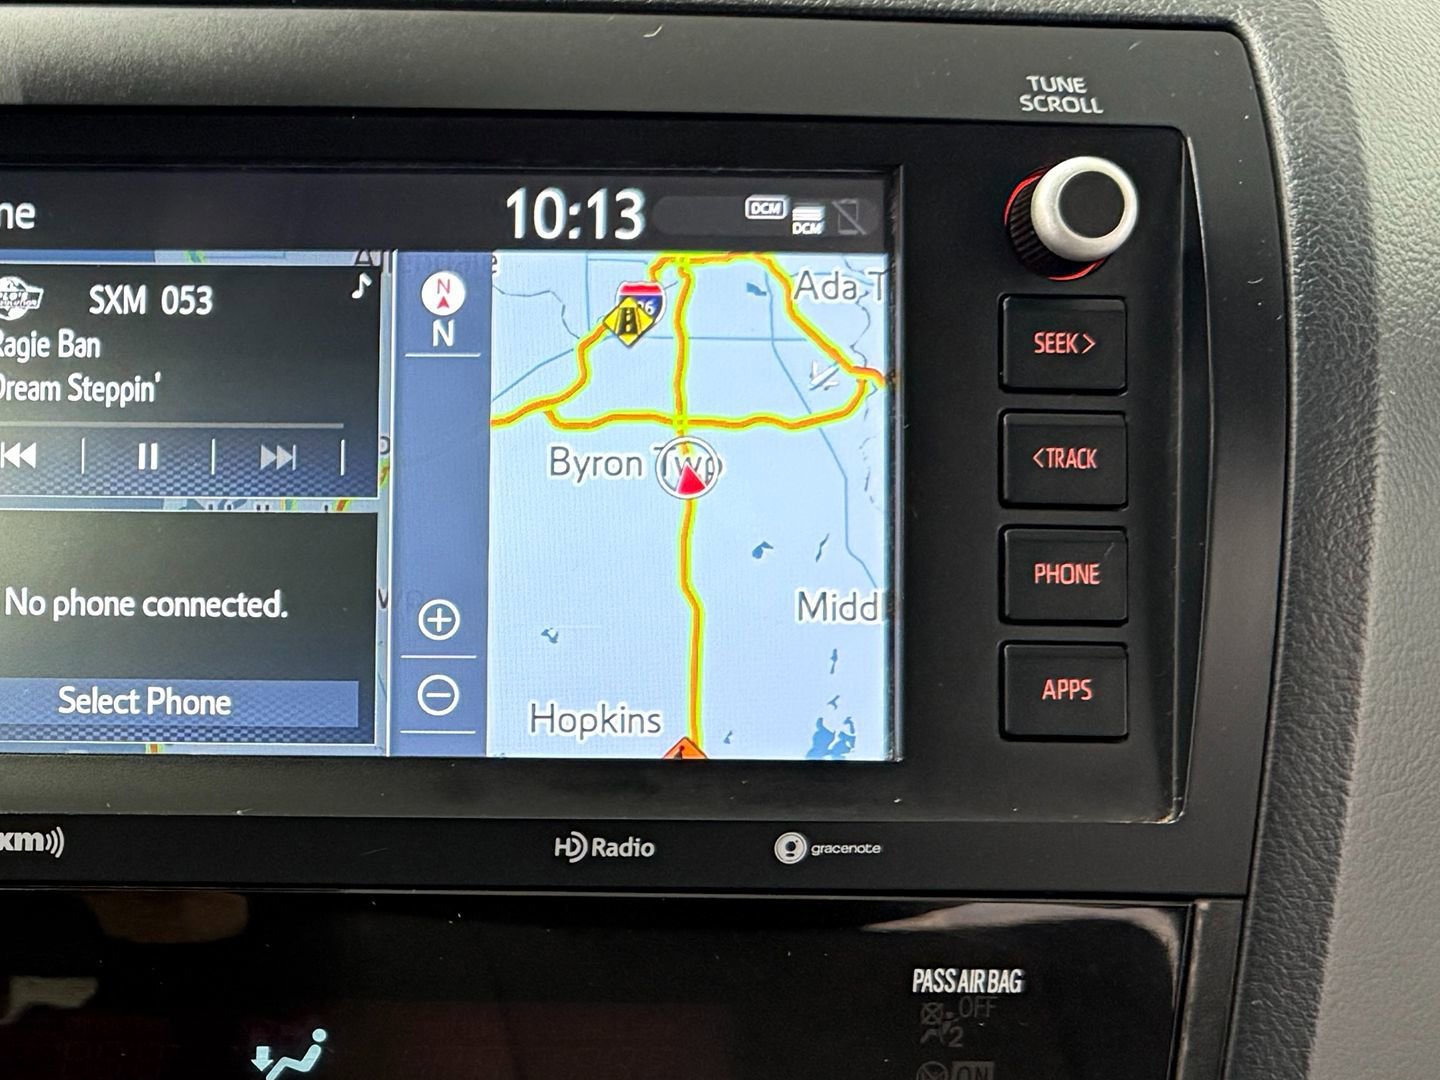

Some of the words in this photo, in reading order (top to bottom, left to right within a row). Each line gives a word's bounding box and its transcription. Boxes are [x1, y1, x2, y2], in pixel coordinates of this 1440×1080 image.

[1026, 76, 1087, 94] TUNE
[1019, 93, 1104, 114] SCROLL
[506, 188, 645, 241] 10:13
[751, 201, 781, 216] DCM
[791, 221, 823, 235] DCM
[793, 270, 857, 301] Ada
[89, 285, 147, 315] SXM
[161, 285, 213, 316] 053
[58, 330, 101, 359] Ban
[432, 319, 455, 347] N
[68, 372, 162, 409] Steppin'
[549, 446, 642, 484] Byron
[1034, 562, 1100, 585] PHONE
[6, 587, 47, 616] No
[53, 588, 136, 621] phone
[142, 590, 289, 619] connected.
[58, 686, 141, 715] Select
[147, 687, 232, 716] Phone
[1041, 678, 1093, 701] APPS
[531, 703, 661, 740] Hopkins
[592, 837, 656, 858] Radio
[811, 842, 882, 856] gracenote
[912, 968, 957, 993] PASS
[957, 968, 986, 994] AIR
[987, 968, 1025, 994] BAG
